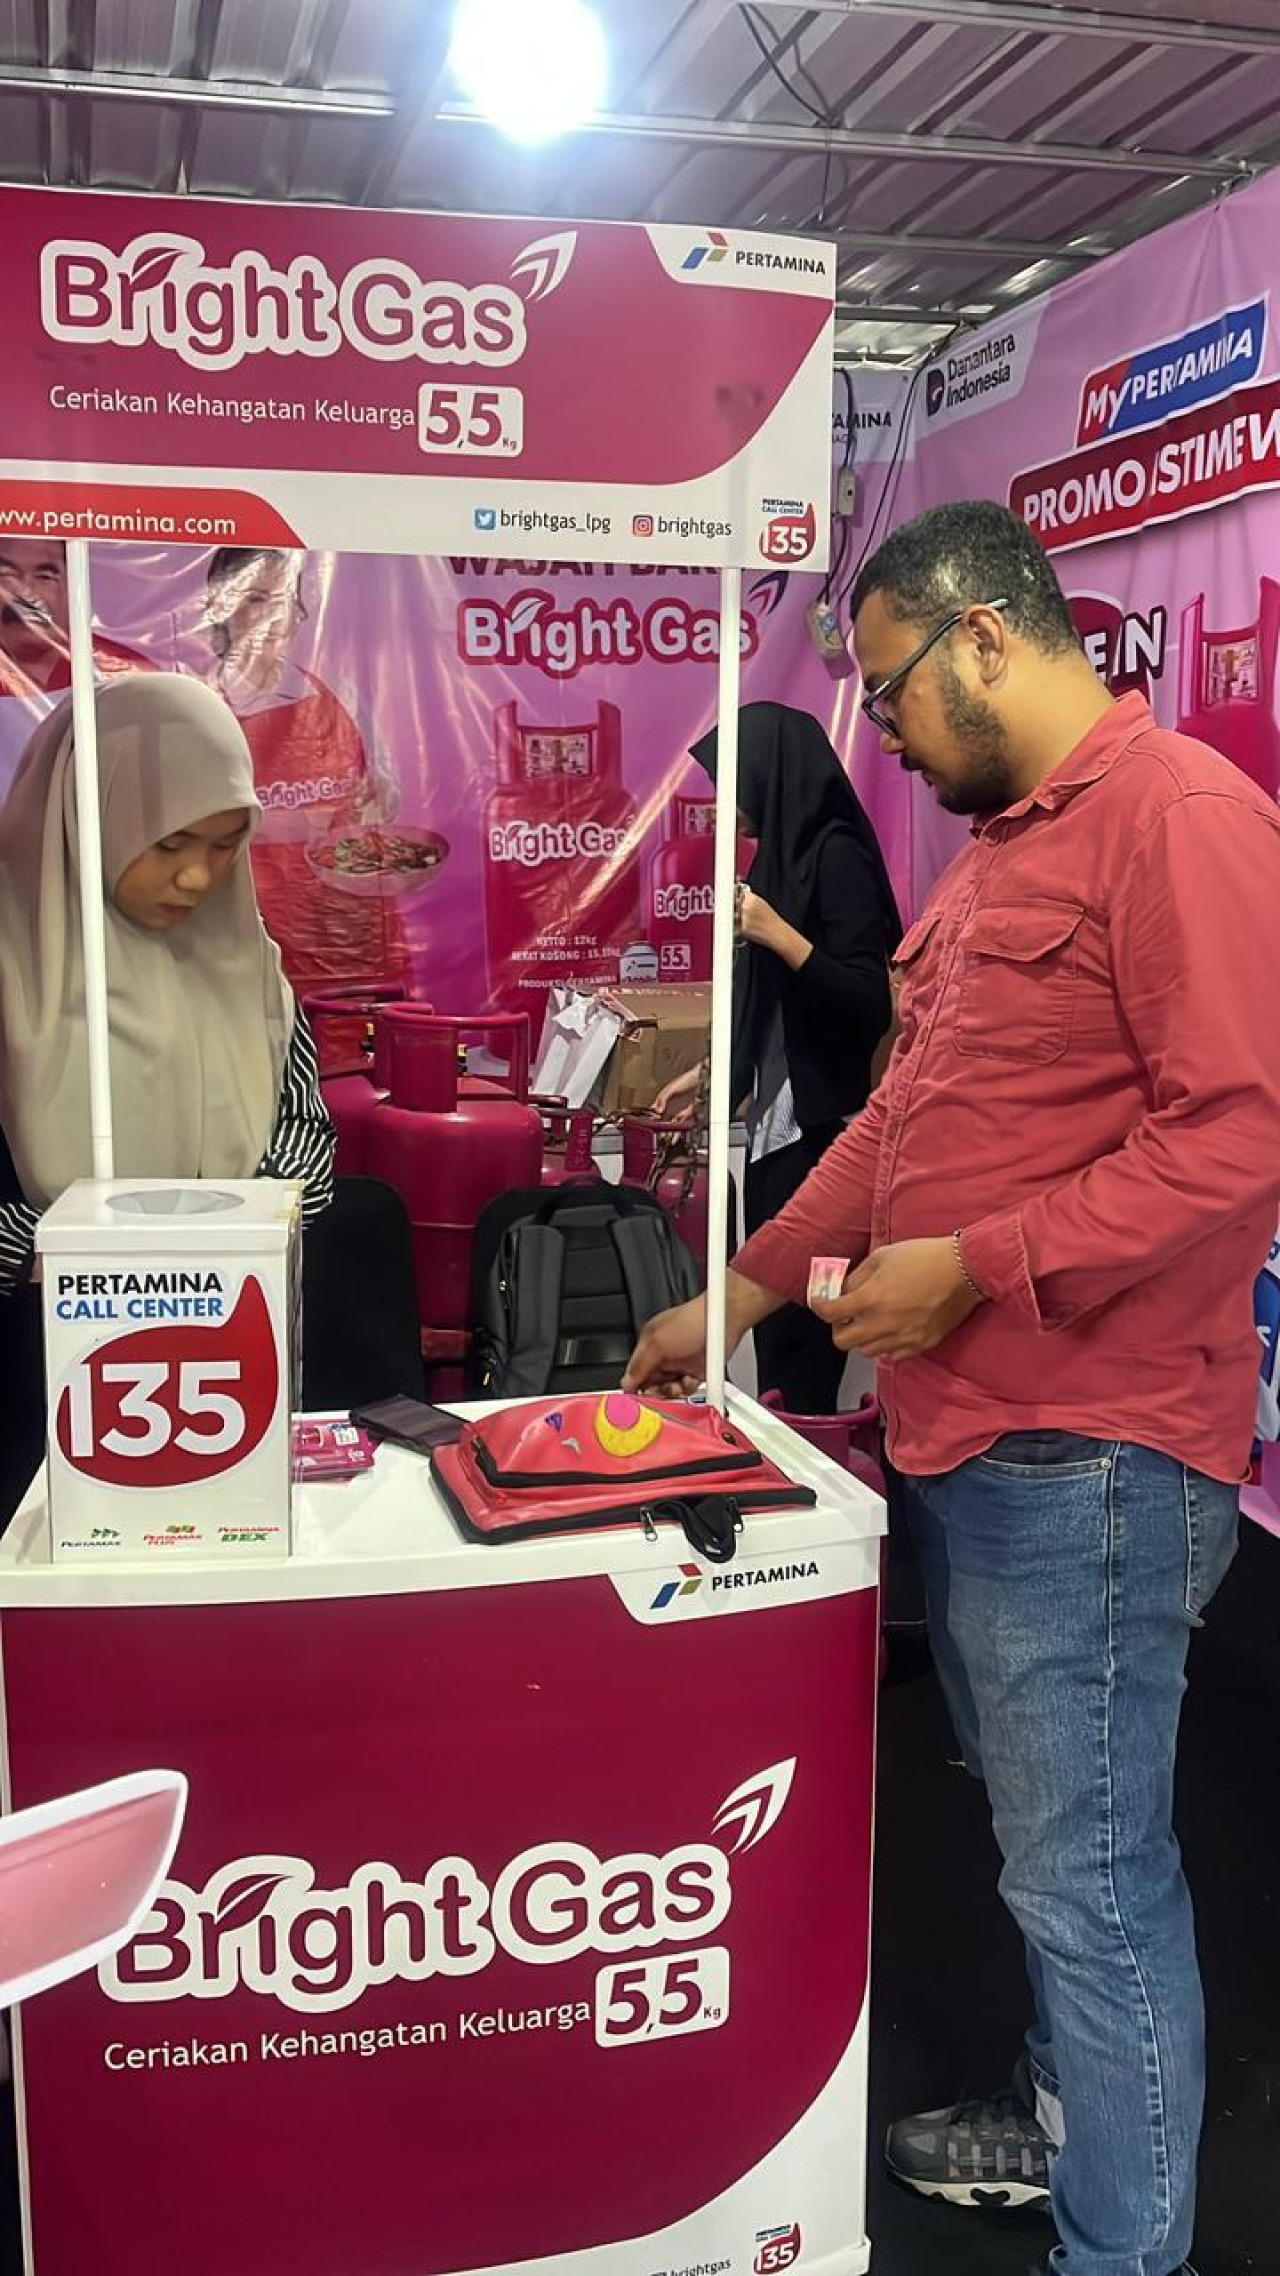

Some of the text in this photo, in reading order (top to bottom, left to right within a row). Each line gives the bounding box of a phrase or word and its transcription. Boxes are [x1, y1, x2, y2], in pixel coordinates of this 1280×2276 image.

[735, 250, 826, 275] PERTAMINA
[51, 243, 517, 359] Bright Gas
[947, 333, 1015, 381] Danantara
[49, 385, 415, 429] Ceriakan Kehangatan Keluarga
[946, 361, 1011, 408] Indonesia
[426, 390, 502, 449] 5,5
[1023, 459, 1146, 531] PROMO
[501, 509, 732, 538] brightgas_lpg brightgas
[762, 525, 808, 555] 135
[463, 596, 636, 672] Bright
[489, 821, 575, 864] Bright
[656, 885, 713, 919] Bright
[58, 1272, 223, 1295] PERTAMINA
[56, 1297, 224, 1320] CALL CENTER
[65, 1361, 246, 1457] 135
[711, 1562, 819, 1591] PERTAMINA
[115, 1859, 717, 1996] Bright Gas
[605, 1959, 721, 2034] 5,5 Kg
[104, 2002, 590, 2072] Ceriakan Kehangatan Keluarga
[756, 2242, 795, 2271] 135
